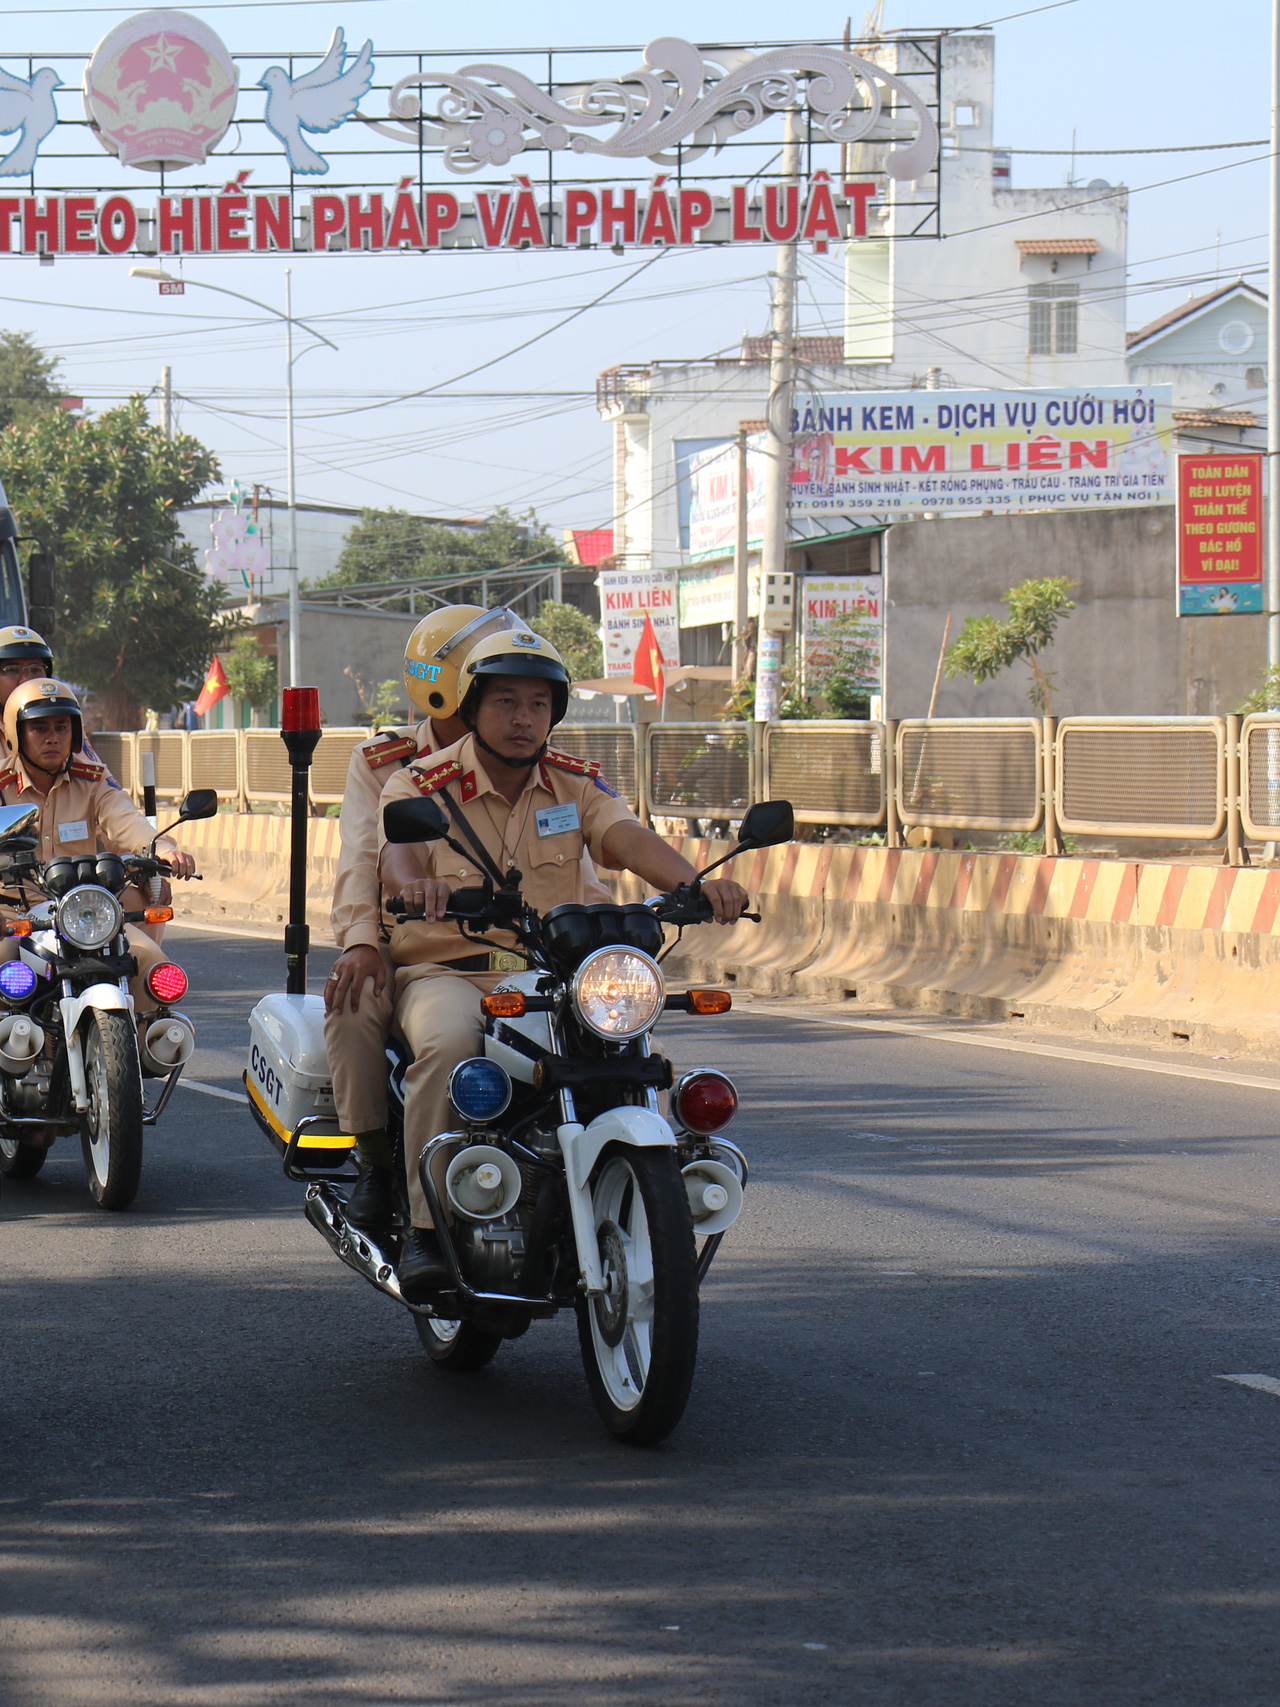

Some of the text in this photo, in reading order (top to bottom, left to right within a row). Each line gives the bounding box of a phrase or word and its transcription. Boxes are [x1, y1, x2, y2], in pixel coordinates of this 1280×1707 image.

[157, 169, 292, 252] HIẾN
[312, 176, 459, 250] PHÁP
[473, 174, 547, 248] VÀ
[563, 172, 714, 246] PHÁP
[730, 168, 878, 254] LUẬT
[161, 283, 183, 293] 5M
[789, 400, 852, 432] BÁNH
[862, 405, 914, 431] KEM
[937, 403, 995, 436] DỊCH
[1005, 402, 1037, 434] VỤ
[1045, 392, 1103, 426] CƯỚI
[1113, 389, 1155, 424] HỎI
[835, 435, 1108, 476] KIM LIÊN
[1191, 464, 1249, 479] TOÀN DÂN
[786, 478, 826, 495] HUYÊN:
[828, 479, 855, 494] BÁNH
[858, 481, 881, 494] SINH
[884, 478, 910, 496] NHẬT
[919, 475, 938, 492] KẾT
[970, 478, 1003, 494] PHỤNG
[1040, 477, 1060, 489] CAU
[1069, 475, 1101, 488] TRANG
[1123, 474, 1138, 486] GIA
[1215, 484, 1251, 499] LUYỆN
[812, 500, 844, 509] 0919
[849, 499, 873, 508] 359
[878, 499, 901, 507] 218
[921, 497, 954, 506] 0978
[958, 496, 982, 505] 955
[987, 495, 1011, 504] 335
[1028, 493, 1066, 505] PHỤC
[1071, 493, 1089, 504] VỤ
[1094, 490, 1122, 504] TẬN
[1193, 502, 1223, 516] THÂN
[1185, 522, 1214, 535] THEO
[1199, 538, 1223, 553] BÁC
[606, 592, 634, 610] KIM
[638, 586, 672, 608] LIÊN
[808, 600, 837, 618] KIM
[632, 618, 646, 629] SIN
[607, 662, 632, 672] TRANG
[251, 1044, 283, 1106] CSGT
